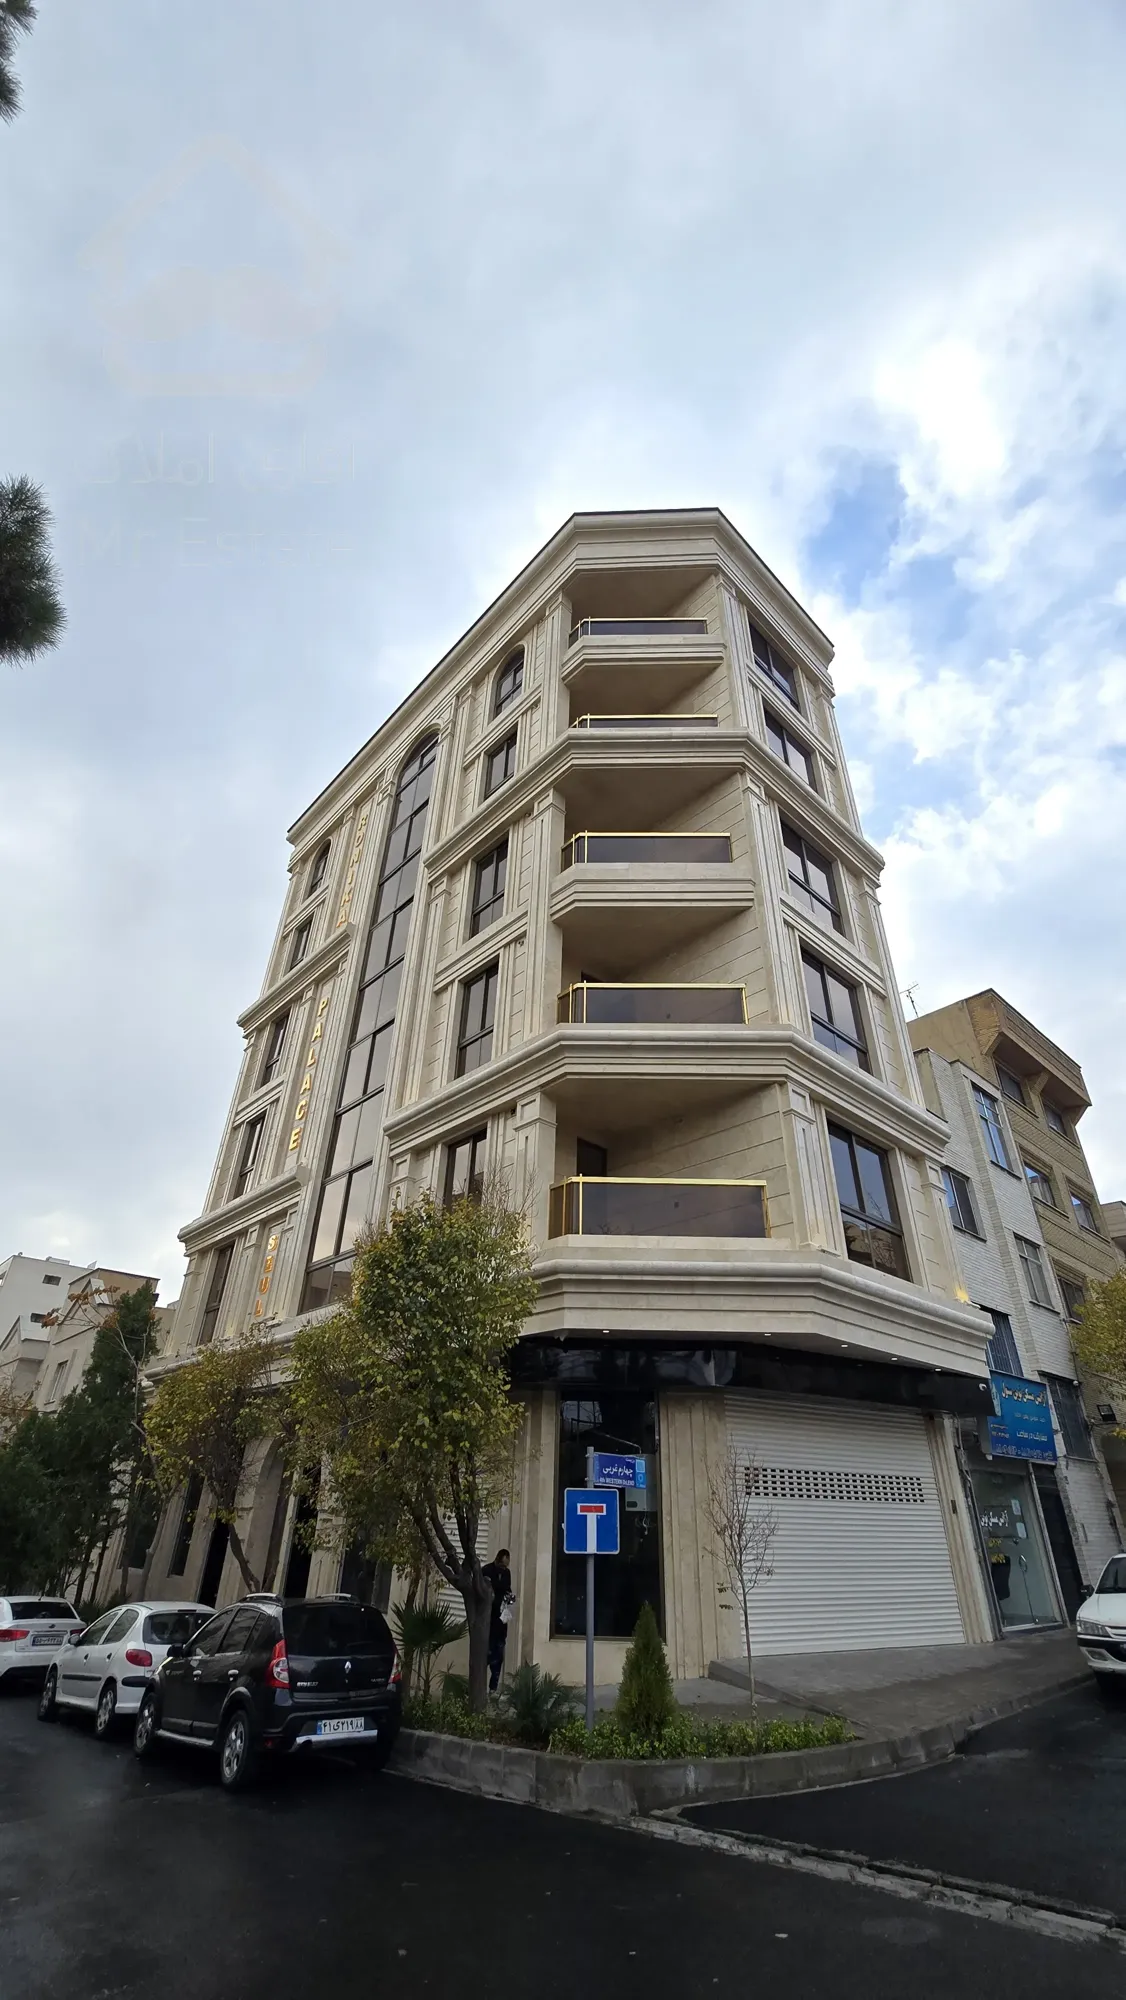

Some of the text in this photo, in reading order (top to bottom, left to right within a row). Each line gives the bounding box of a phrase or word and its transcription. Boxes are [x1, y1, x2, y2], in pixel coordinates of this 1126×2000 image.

[254, 814, 369, 1318] RONIKA PALACE SEUL
[602, 1463, 634, 1477] چهارم غربی
